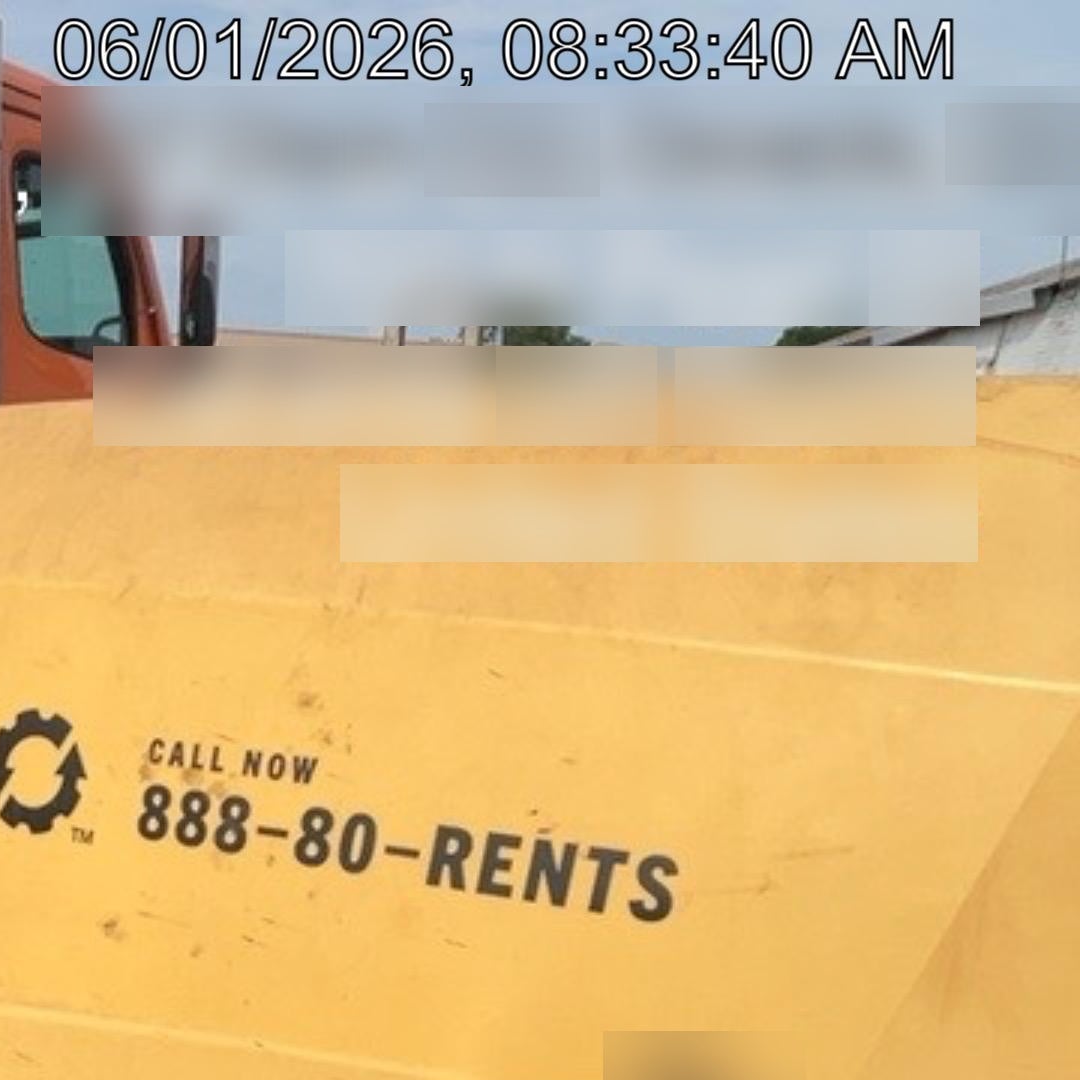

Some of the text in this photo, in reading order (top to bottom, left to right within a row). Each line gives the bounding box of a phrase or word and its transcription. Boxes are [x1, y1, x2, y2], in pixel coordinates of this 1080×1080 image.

[146, 738, 319, 785] CALL NOW
[137, 784, 681, 923] 888-80-RENTS
